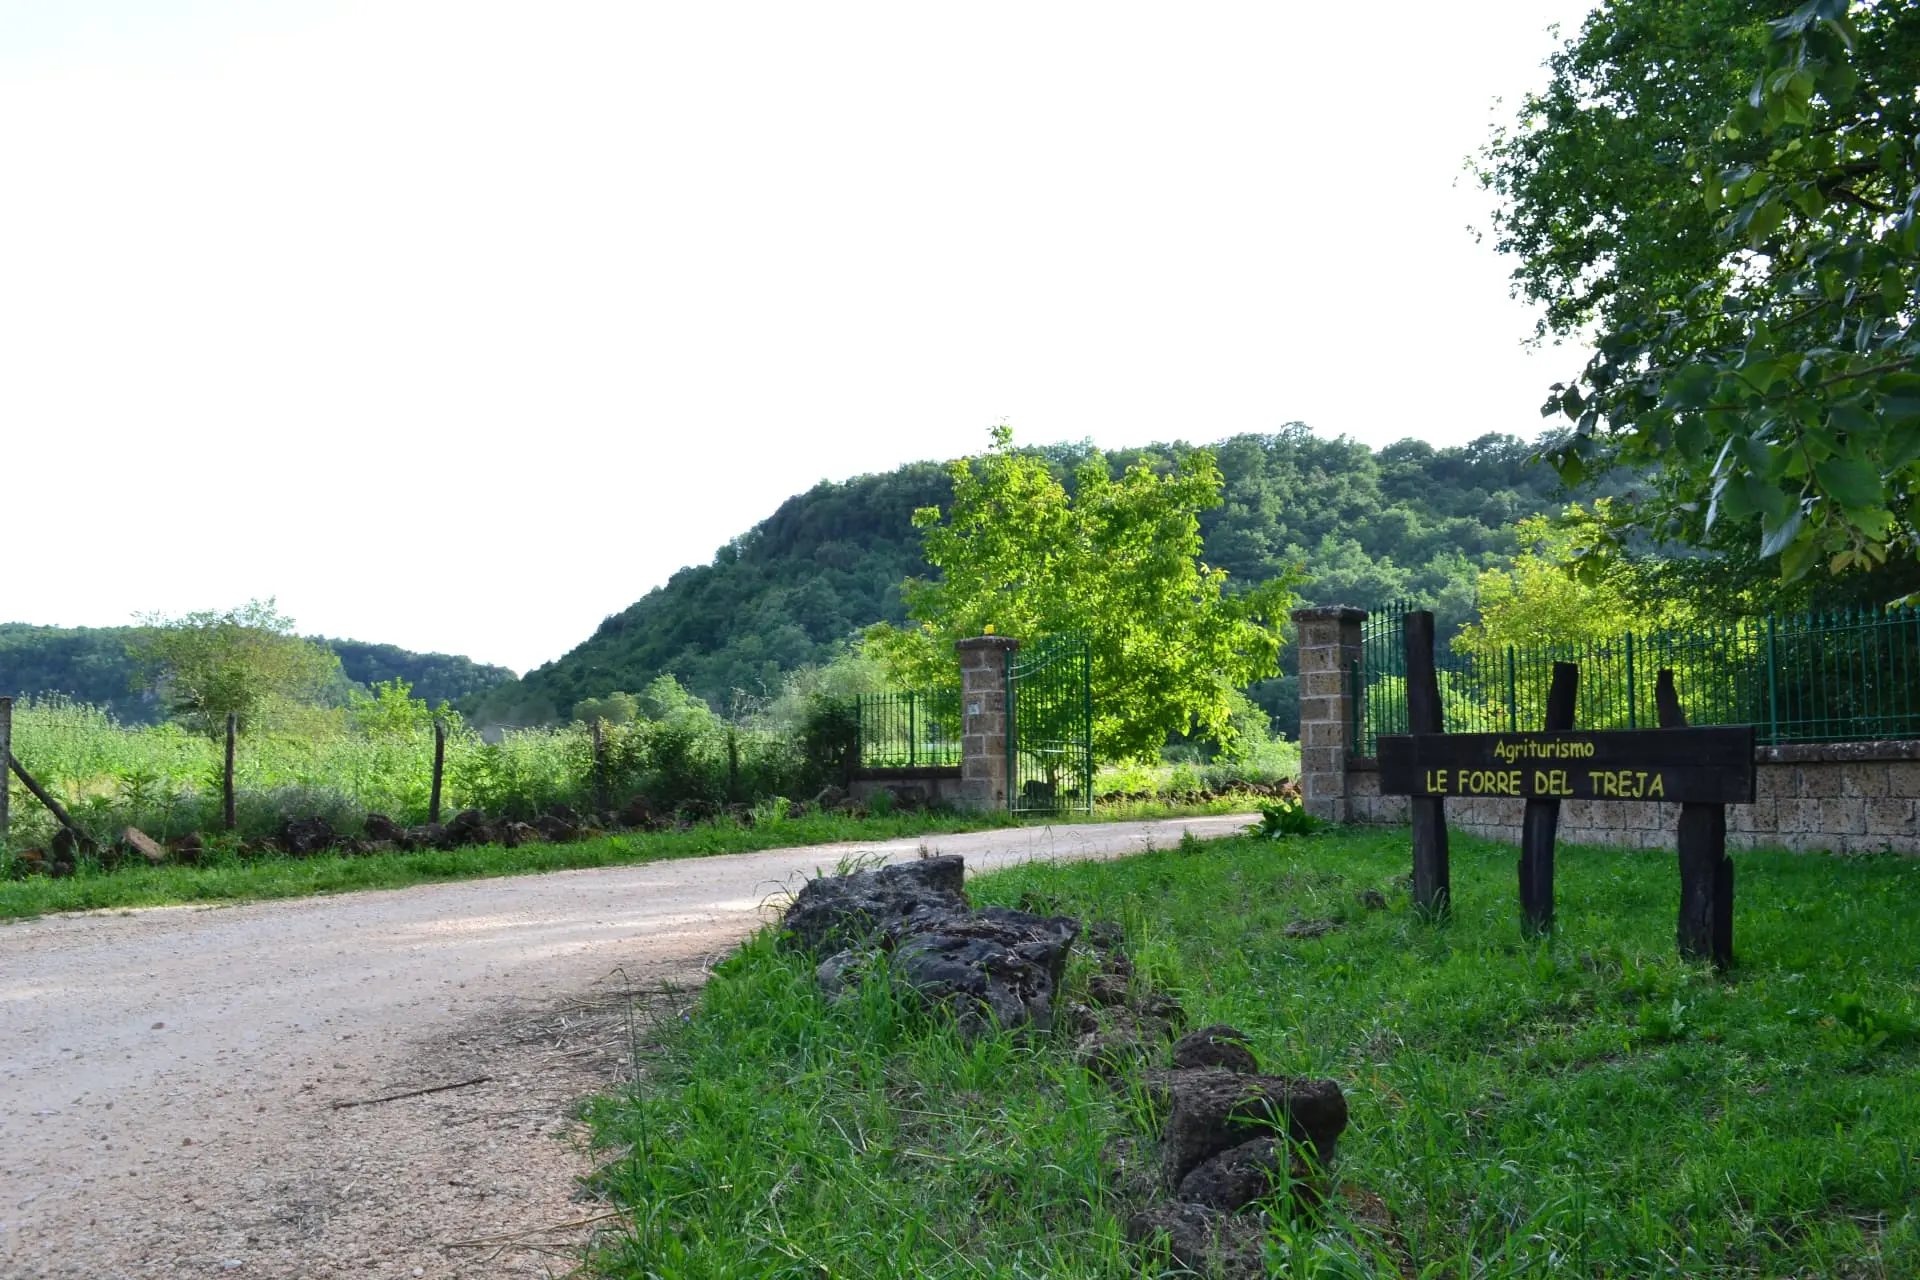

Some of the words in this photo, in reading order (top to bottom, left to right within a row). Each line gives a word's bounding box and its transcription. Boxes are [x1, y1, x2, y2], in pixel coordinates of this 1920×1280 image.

[1494, 739, 1594, 764] Agriturismo
[1426, 769, 1448, 793] LE
[1458, 769, 1522, 795] FORRE
[1534, 769, 1574, 795] DEL
[1588, 770, 1664, 797] TREJA
